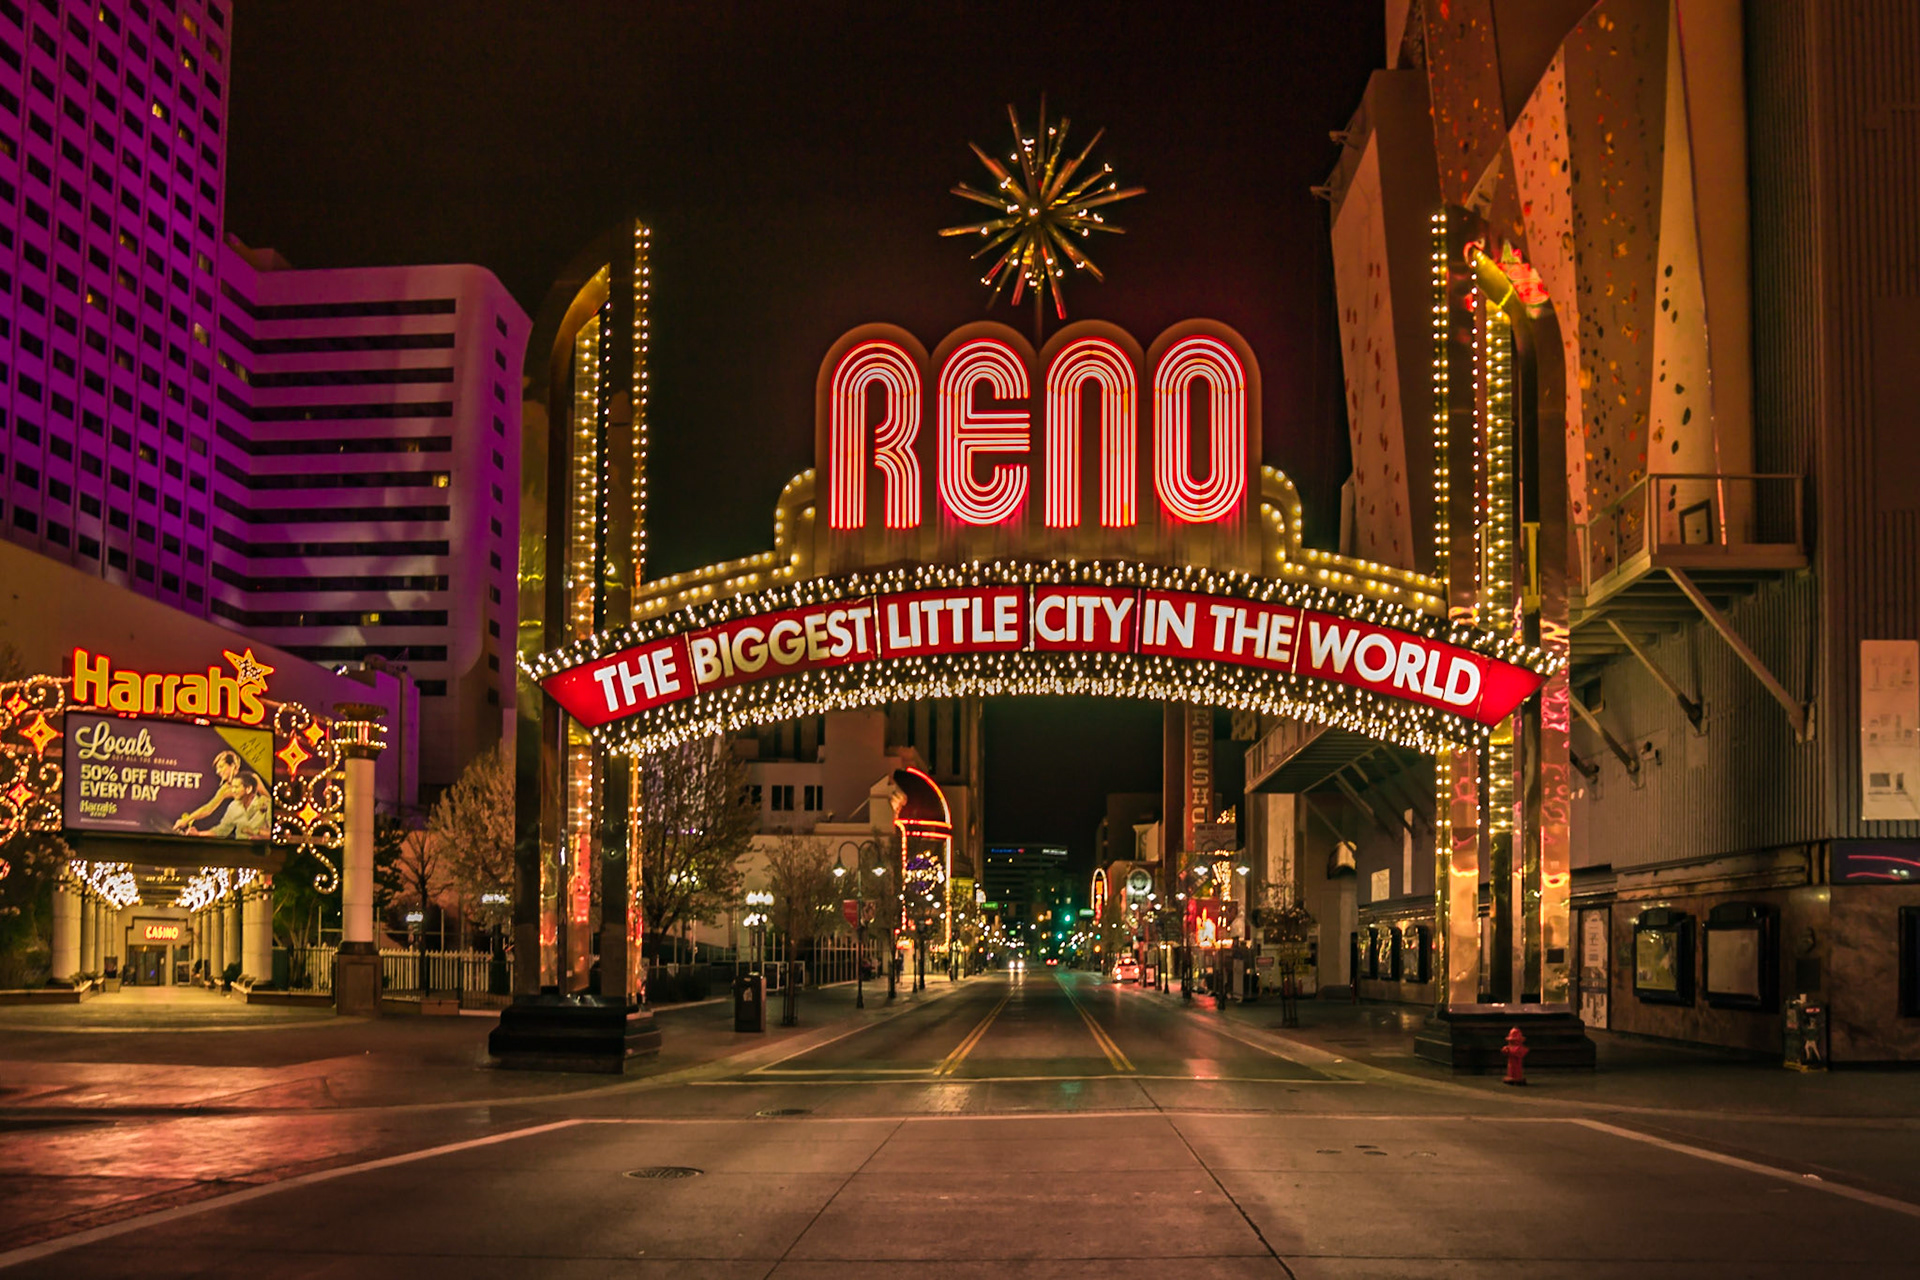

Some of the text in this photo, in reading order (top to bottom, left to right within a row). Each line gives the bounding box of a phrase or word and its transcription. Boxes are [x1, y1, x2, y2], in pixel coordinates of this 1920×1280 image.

[829, 335, 1248, 529] RENO
[593, 595, 1481, 713] THE BIGGEST LITTLE CITY IN THE WORLD
[75, 721, 155, 760] Locals
[80, 781, 160, 802] EVERY DAY
[81, 763, 203, 789] 50% OFF BUFFET
[144, 925, 179, 940] CASINO
